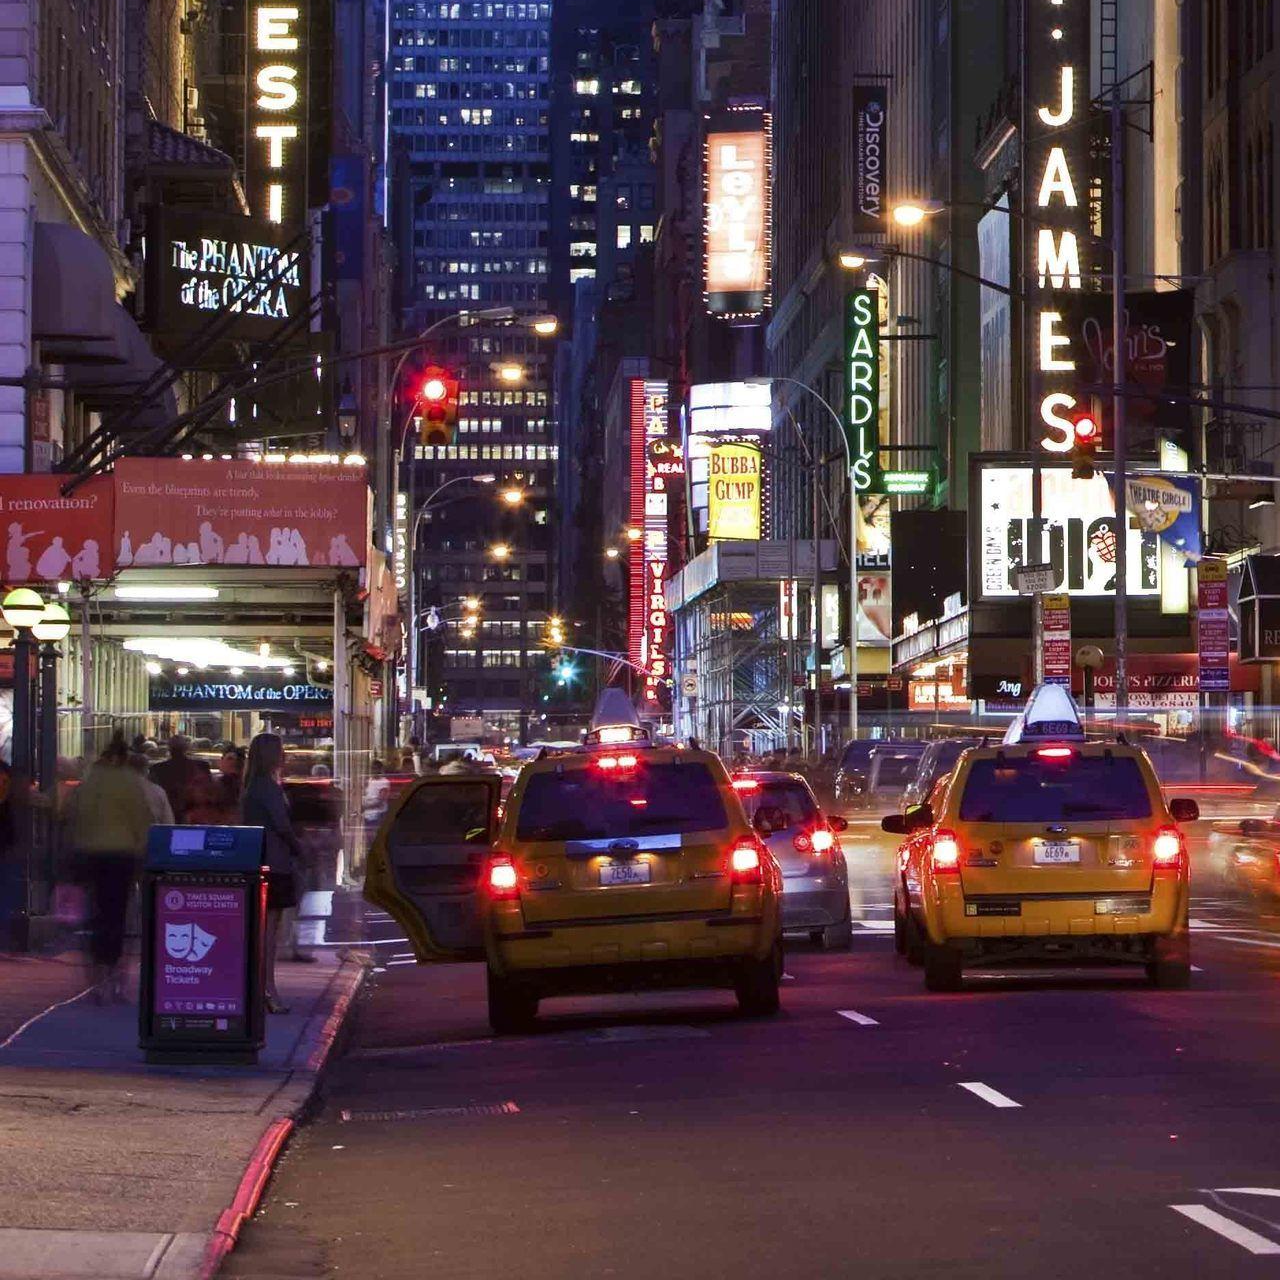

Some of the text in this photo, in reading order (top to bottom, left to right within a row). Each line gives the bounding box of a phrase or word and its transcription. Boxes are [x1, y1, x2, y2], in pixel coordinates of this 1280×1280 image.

[860, 110, 884, 219] Discovery
[171, 239, 300, 287] The PHANTOM
[181, 277, 198, 305] of
[198, 280, 220, 310] the
[711, 452, 758, 475] BUBBA
[122, 482, 146, 495] Even
[148, 483, 162, 495] the
[715, 477, 756, 502] GUMP
[8, 494, 98, 511] renovation?
[294, 508, 308, 518] the
[1093, 675, 1141, 687] JOH'S
[172, 684, 253, 700] PHANTOM
[254, 686, 267, 700] of
[267, 686, 282, 700] the
[1129, 693, 1150, 701] OW
[1043, 723, 1068, 734] 6E69
[165, 963, 213, 977] Broadway
[165, 975, 200, 985] Tickets
